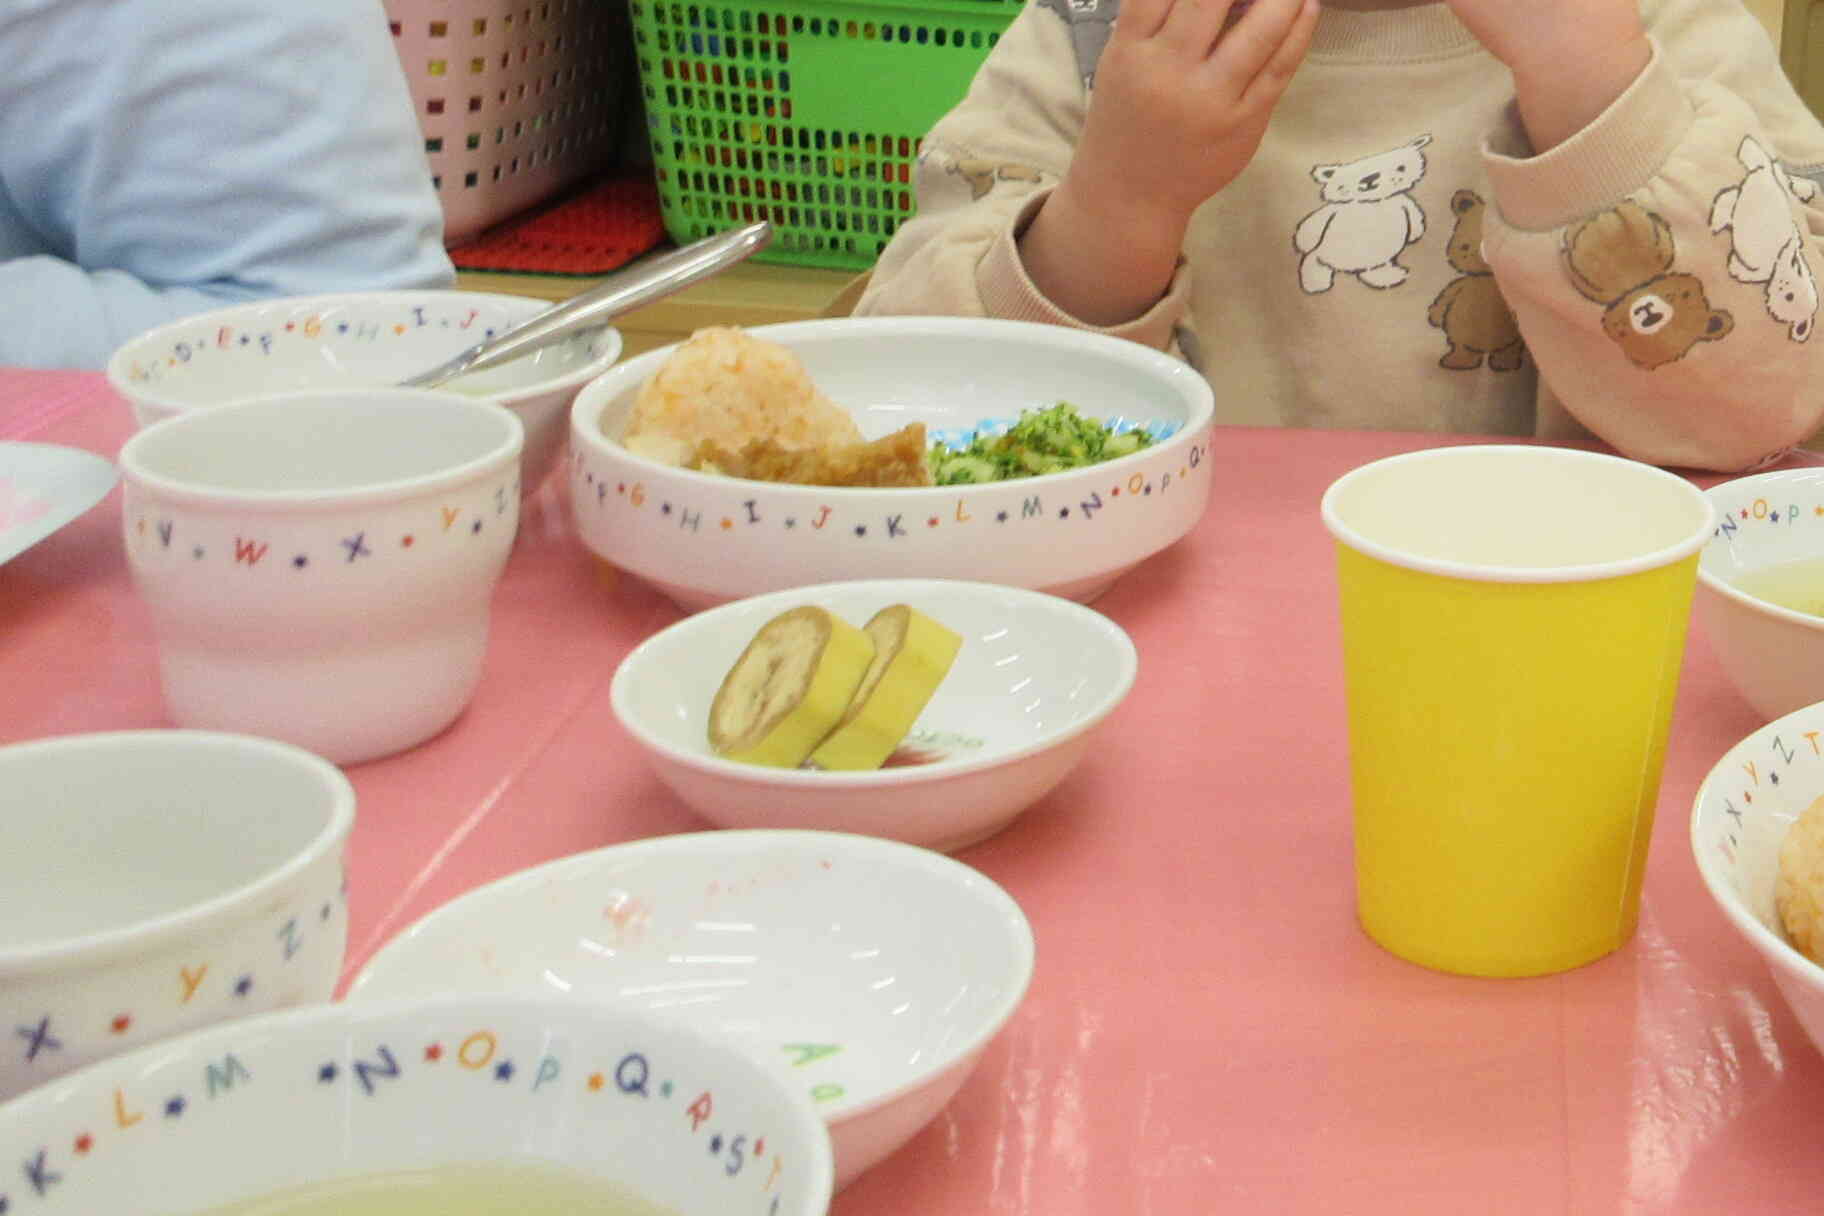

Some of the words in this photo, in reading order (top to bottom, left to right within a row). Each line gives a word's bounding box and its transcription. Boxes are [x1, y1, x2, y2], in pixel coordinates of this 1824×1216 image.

[413, 307, 425, 326] I
[460, 310, 478, 329] J
[680, 508, 700, 532] H
[744, 499, 760, 524] I
[811, 505, 832, 529] J
[887, 514, 906, 538] K
[955, 499, 973, 523] L
[1021, 496, 1043, 519] M
[1080, 492, 1103, 519] N
[1128, 472, 1143, 495] O
[1160, 474, 1171, 494] P
[1721, 513, 1738, 540] N
[1753, 499, 1768, 520] O
[1788, 504, 1800, 528] P
[158, 519, 173, 548] V
[233, 536, 268, 567] W
[341, 531, 371, 563] X
[1743, 761, 1759, 785] Y
[1772, 735, 1795, 765] Z
[1803, 731, 1821, 756] T
[15, 1015, 62, 1064] X
[179, 962, 209, 1003] Y
[276, 917, 304, 962] Z
[22, 1150, 62, 1198] K
[114, 1088, 145, 1129] L
[205, 1053, 251, 1101] M
[353, 1044, 400, 1097] N
[458, 1030, 496, 1071] O
[531, 1055, 560, 1094] P
[615, 1052, 649, 1098] Q
[686, 1090, 713, 1133] R
[725, 1133, 746, 1177] S
